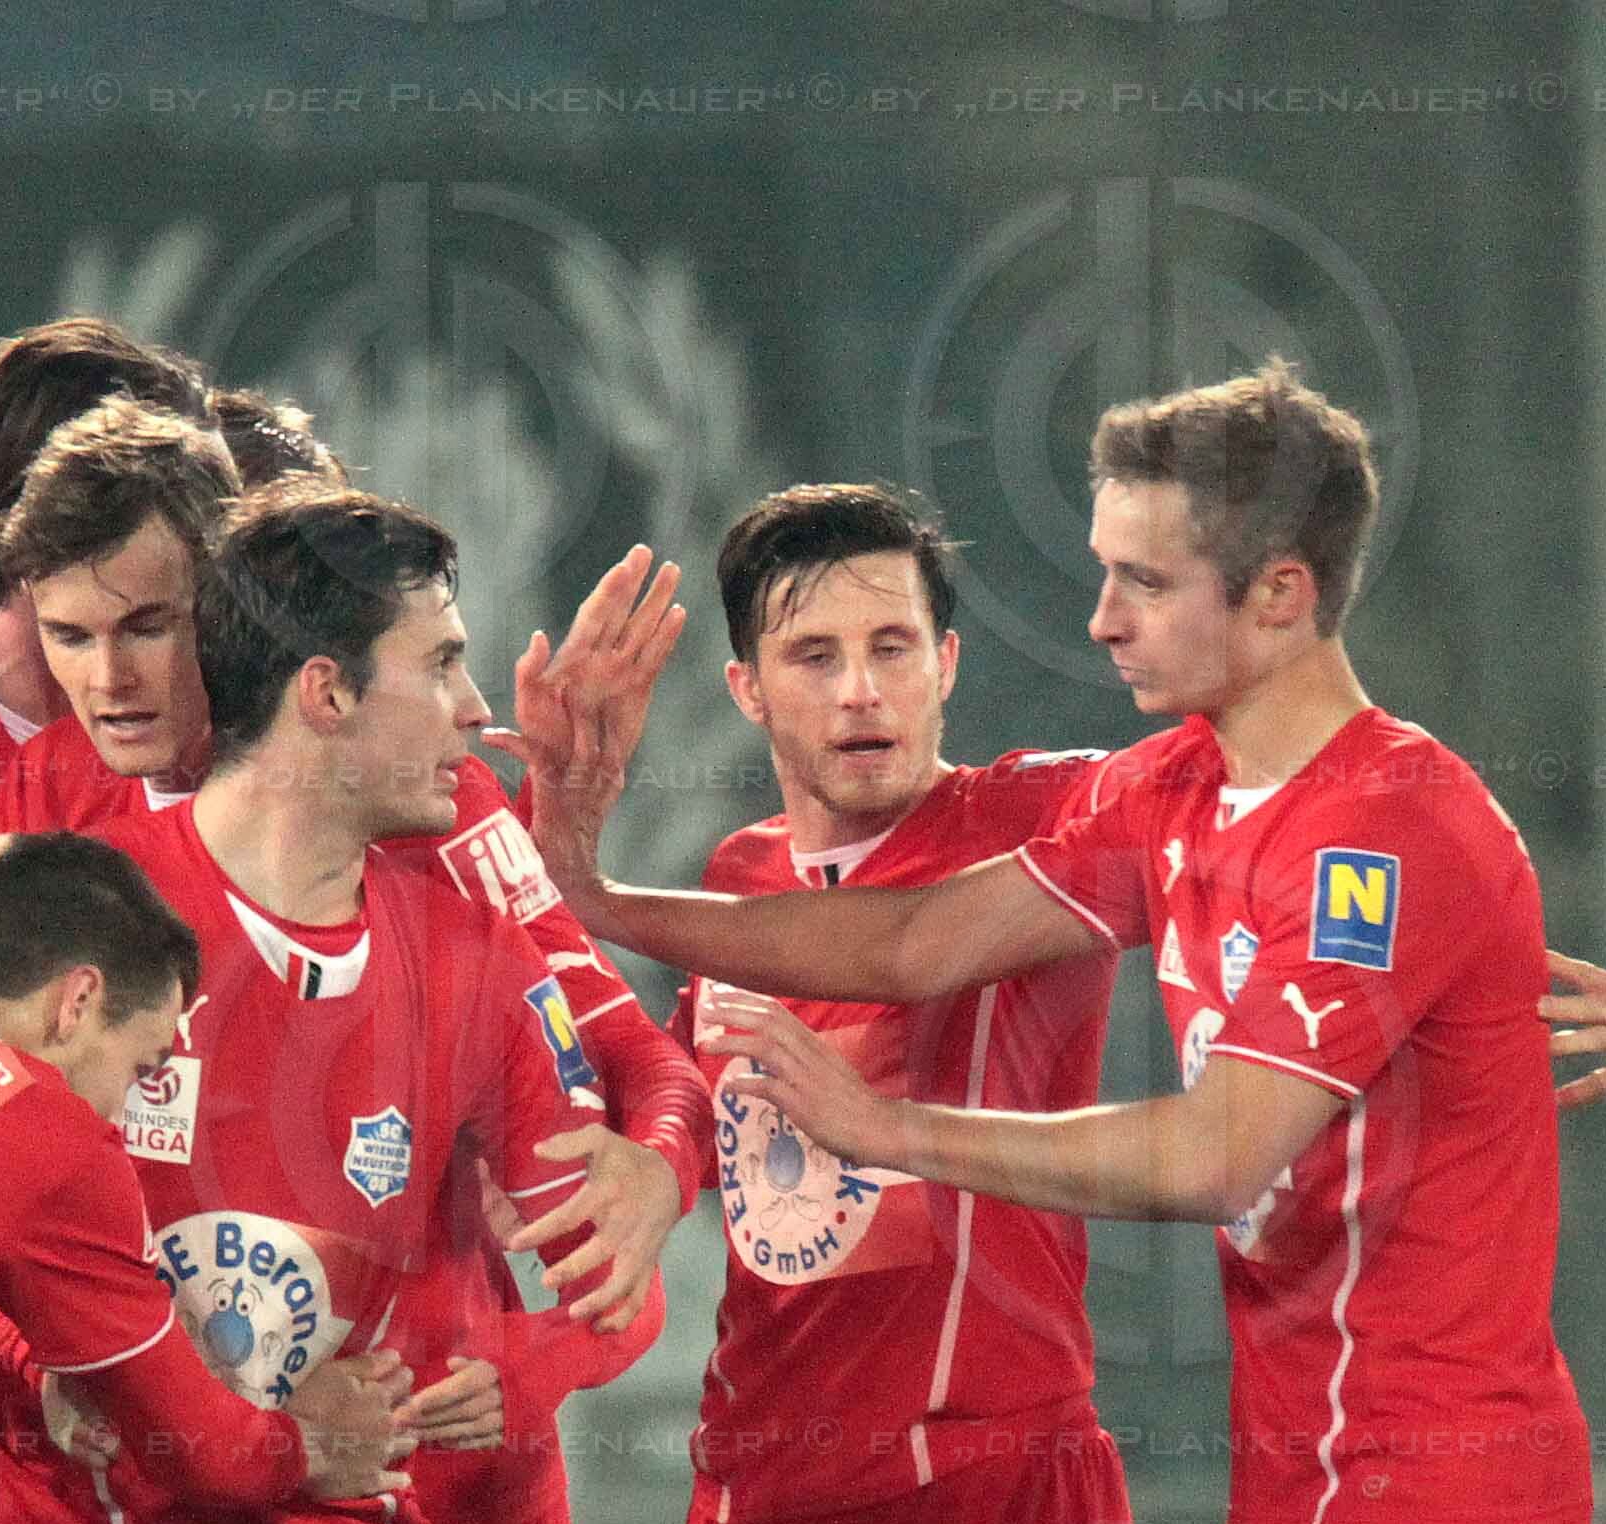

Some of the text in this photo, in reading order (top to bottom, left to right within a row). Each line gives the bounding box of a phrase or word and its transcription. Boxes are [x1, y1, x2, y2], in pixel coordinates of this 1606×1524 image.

[1328, 862, 1387, 927] N
[123, 1124, 188, 1155] LIGA
[124, 1109, 189, 1131] BUNDES
[754, 1226, 840, 1275] GmbH
